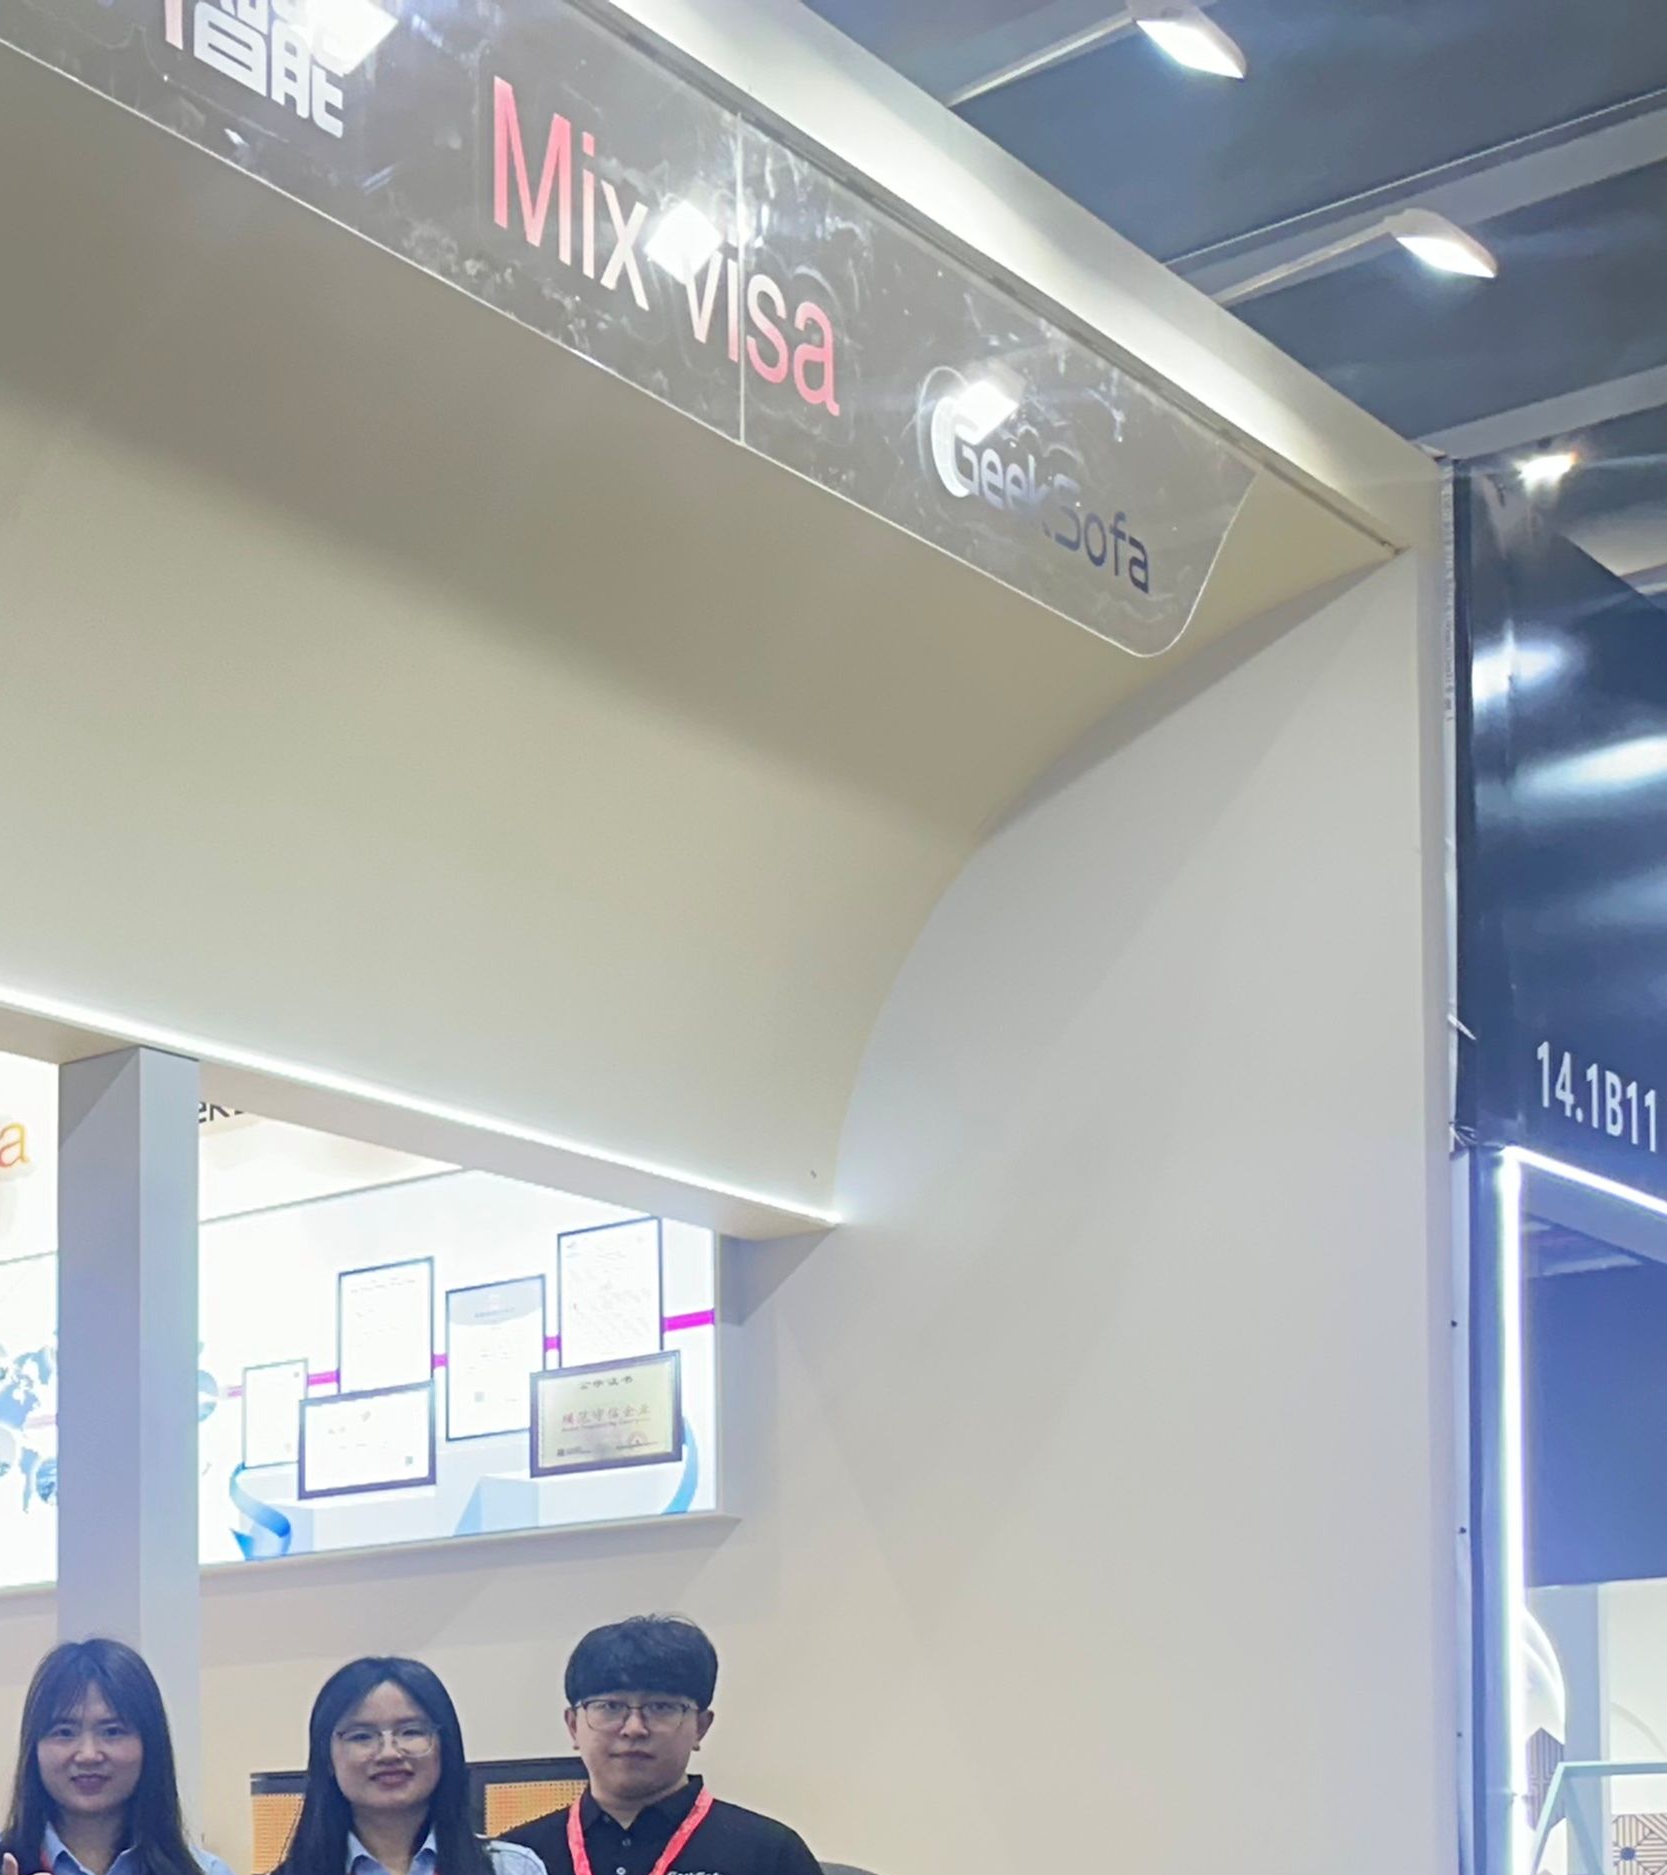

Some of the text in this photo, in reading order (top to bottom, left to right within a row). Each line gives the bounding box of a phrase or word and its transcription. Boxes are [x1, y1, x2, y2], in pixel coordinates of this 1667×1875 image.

[493, 75, 841, 417] Mix visa
[1536, 1040, 1657, 1153] 14.1B11
